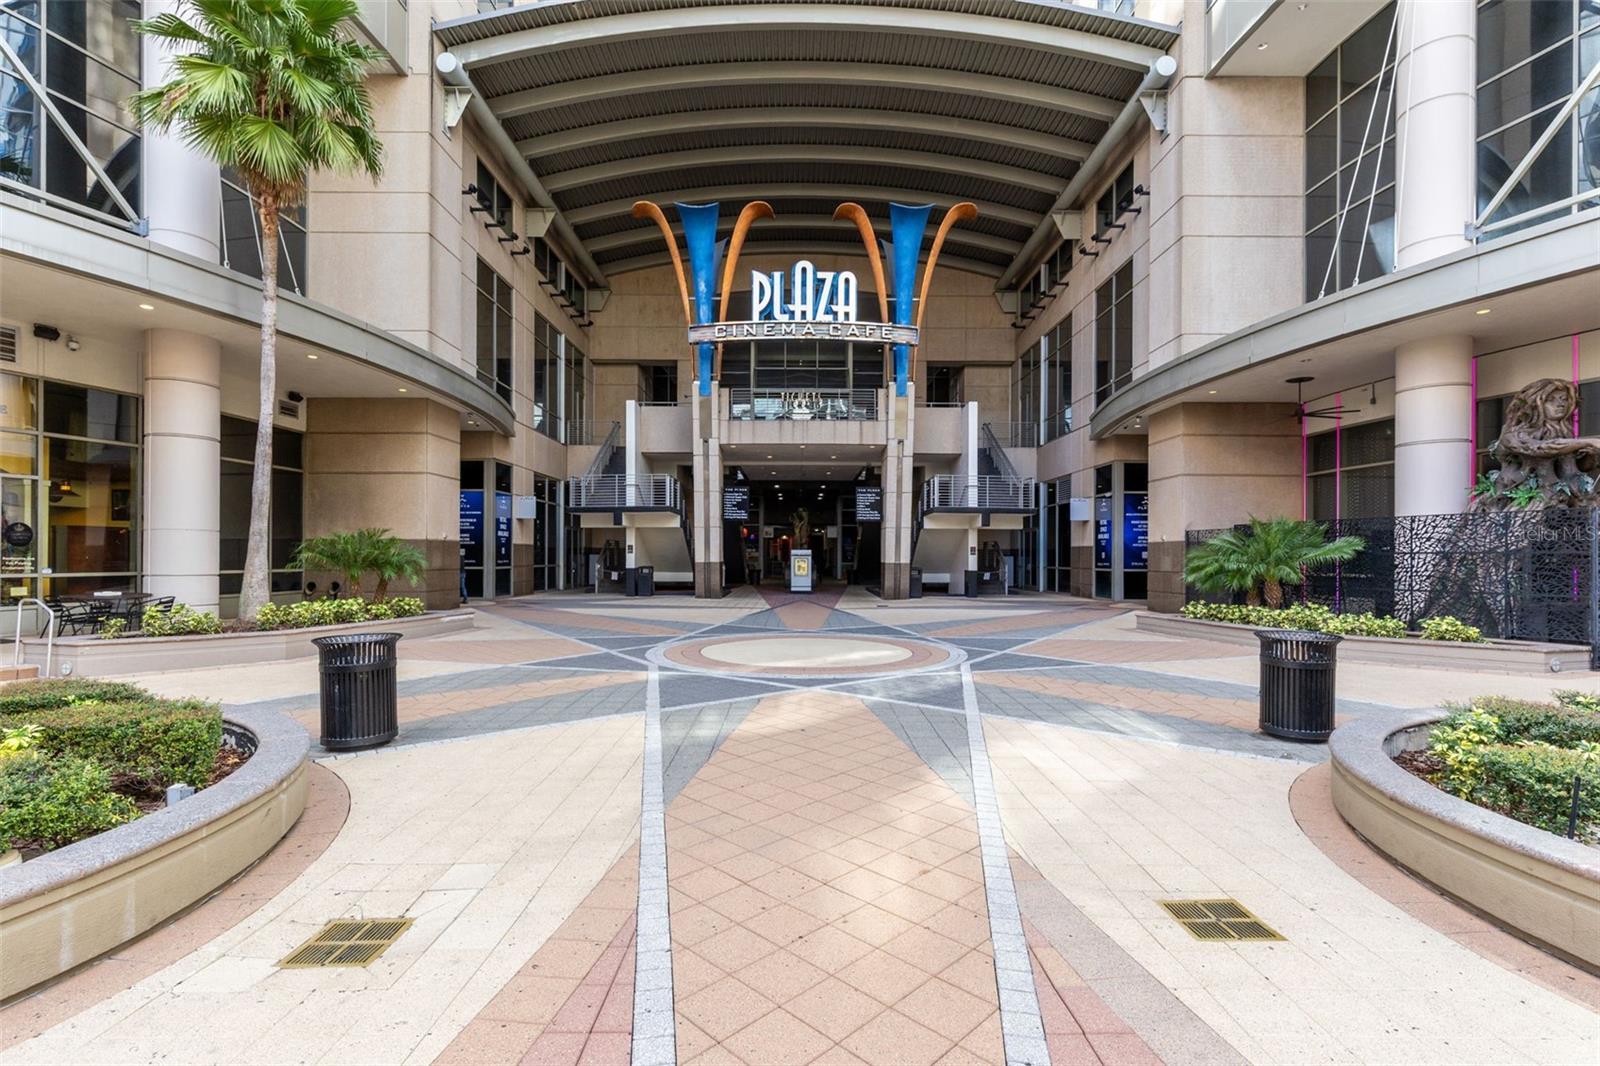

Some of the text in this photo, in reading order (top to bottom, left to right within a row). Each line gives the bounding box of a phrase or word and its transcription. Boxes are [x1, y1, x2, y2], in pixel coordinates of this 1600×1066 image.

[751, 259, 858, 322] PLAZA
[714, 322, 894, 340] CINEMA CAFE
